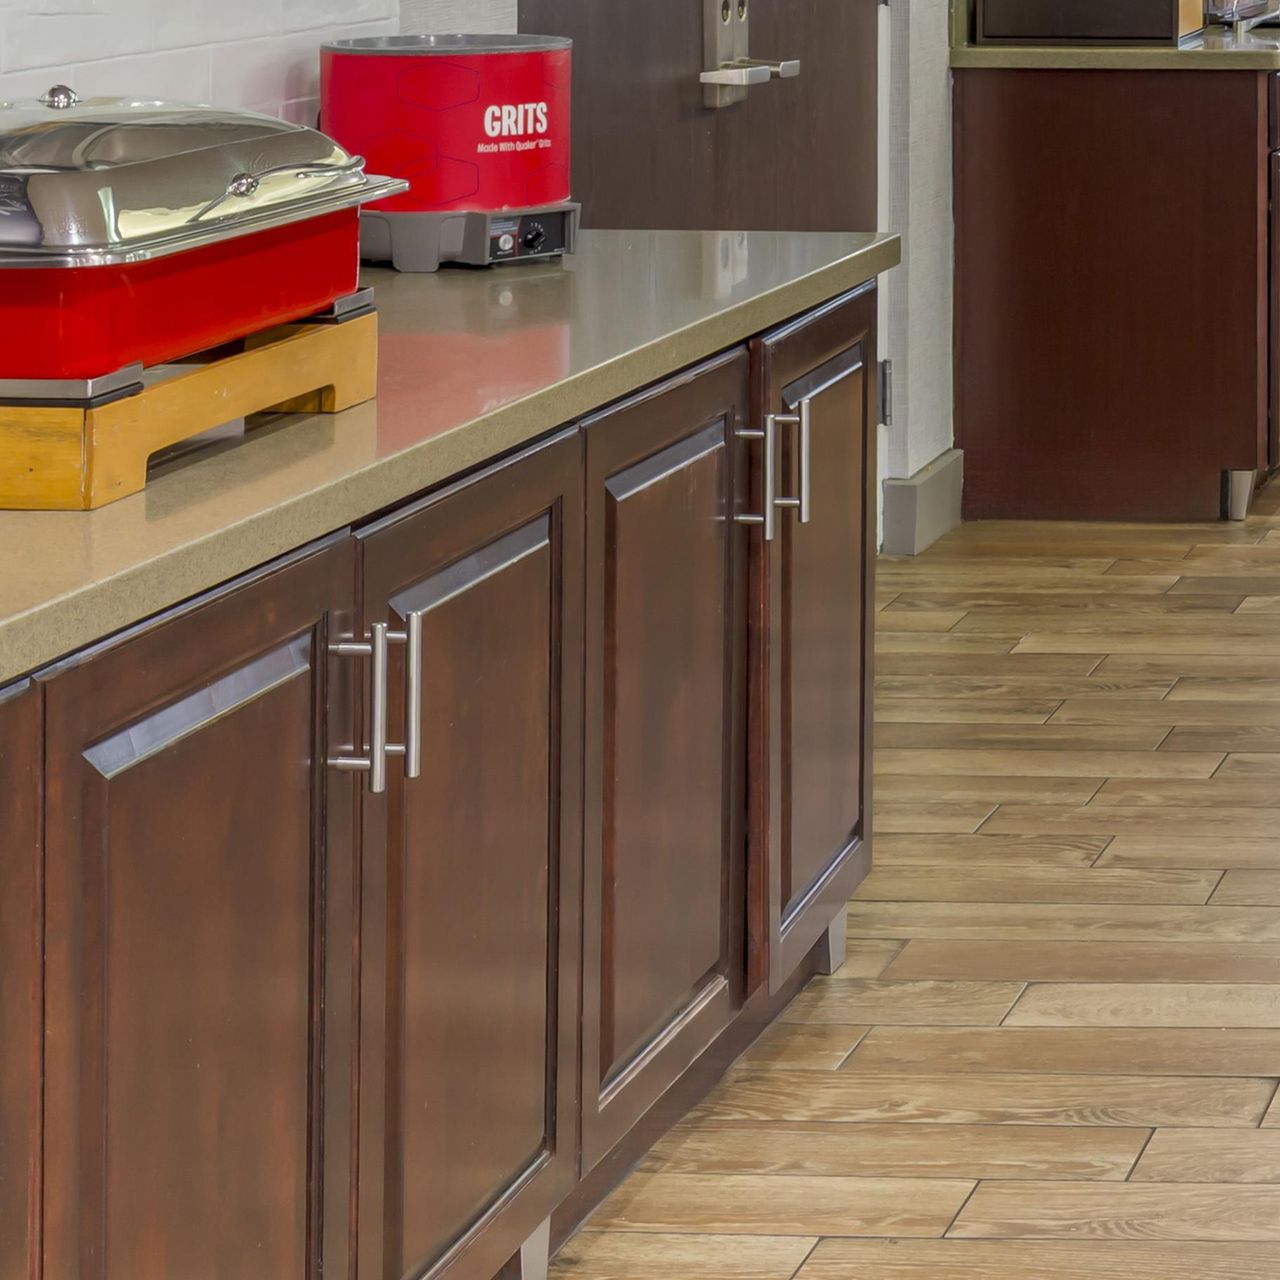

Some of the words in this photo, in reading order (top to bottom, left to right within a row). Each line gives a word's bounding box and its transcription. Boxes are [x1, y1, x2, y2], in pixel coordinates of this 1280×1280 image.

[484, 101, 548, 137] GRITS
[477, 142, 498, 153] Made
[499, 141, 515, 152] With
